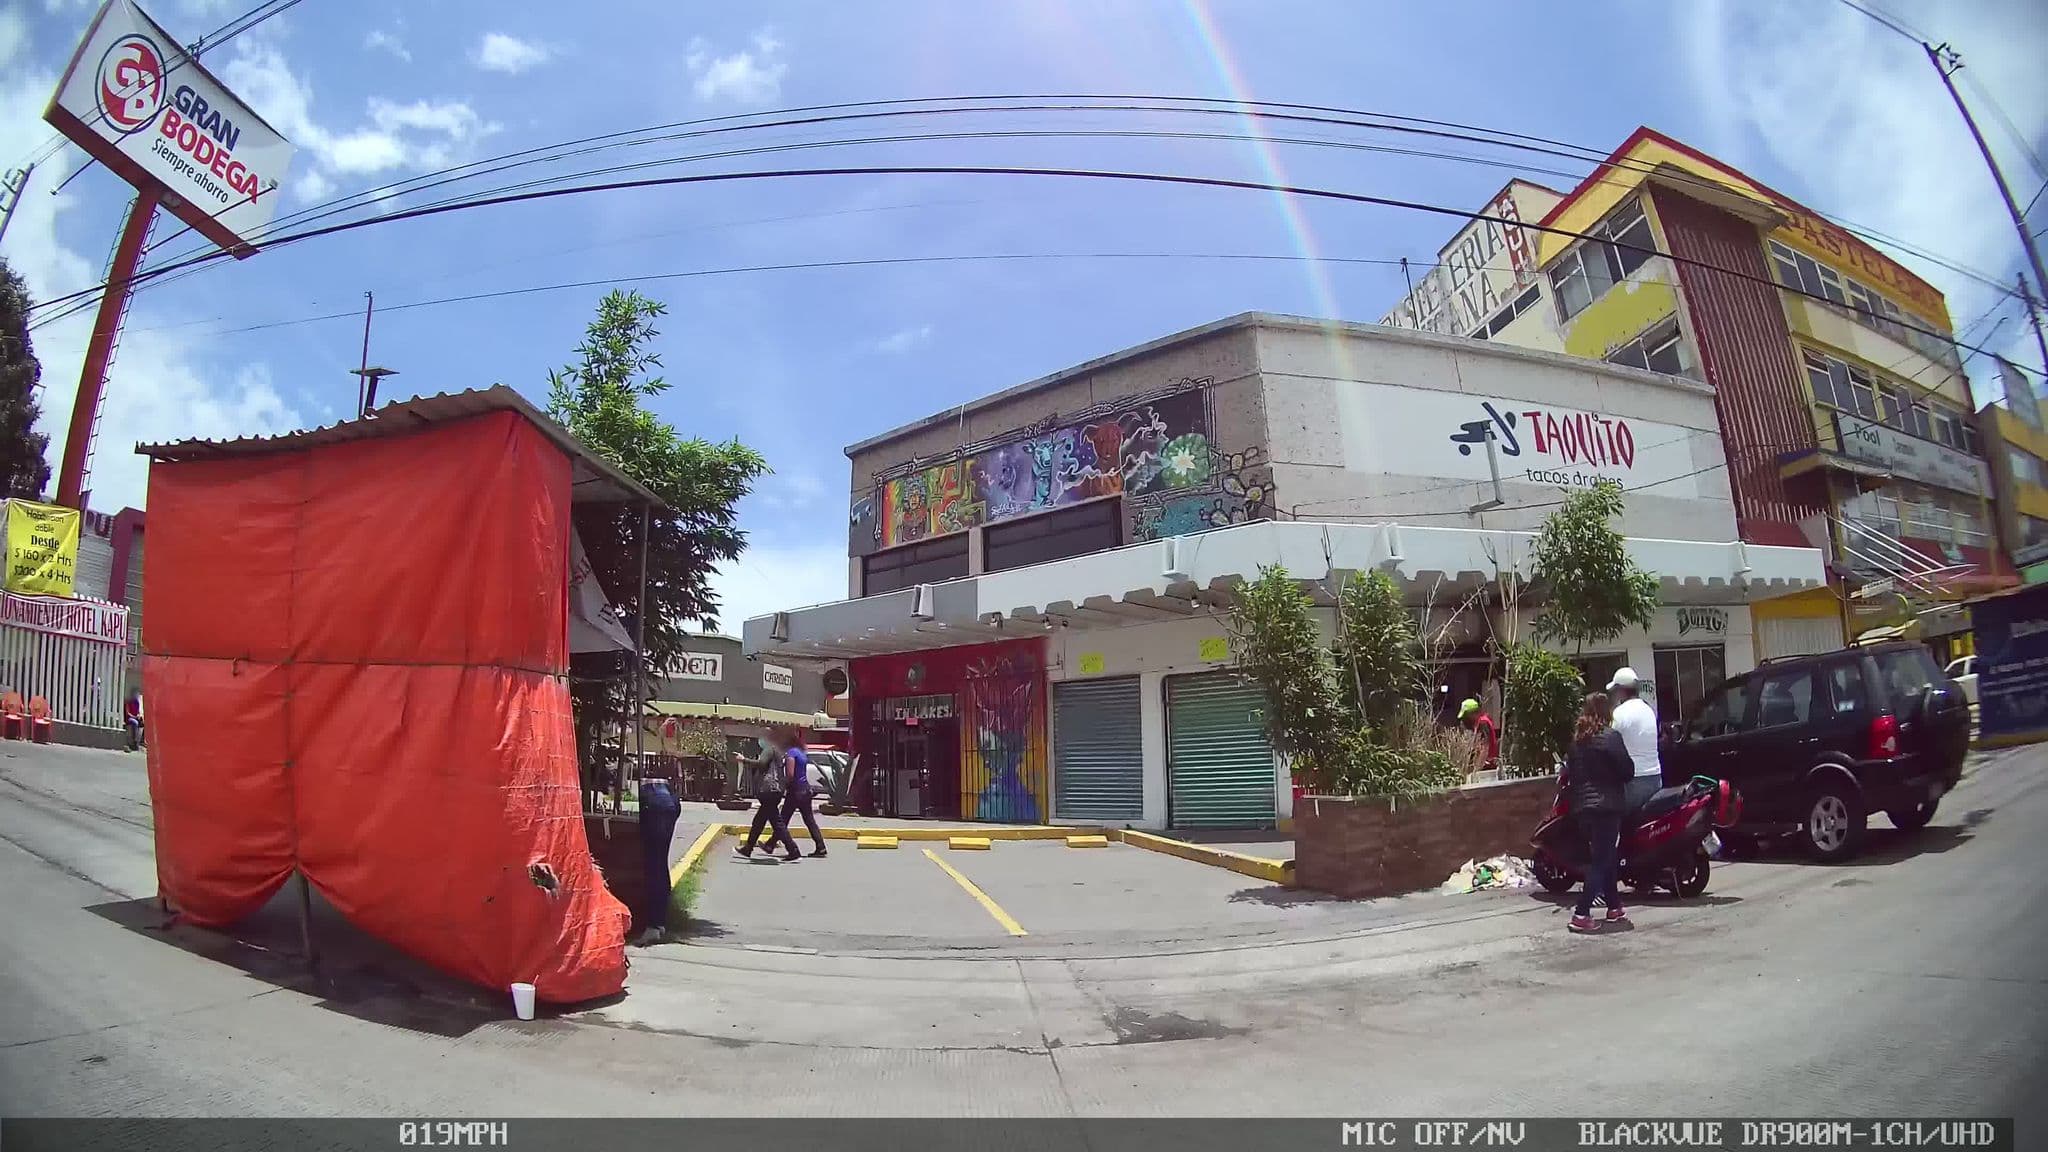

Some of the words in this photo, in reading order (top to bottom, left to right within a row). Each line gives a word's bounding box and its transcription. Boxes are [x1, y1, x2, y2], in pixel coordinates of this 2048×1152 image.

[174, 85, 240, 152] GRAN
[159, 107, 259, 205] BODEGA
[151, 138, 196, 180] Siempre
[194, 173, 229, 204] ahorro
[1853, 423, 1881, 446] Pool
[1526, 467, 1570, 485] tacos
[30, 535, 60, 549] Desde
[57, 554, 72, 567] Hrs
[56, 571, 71, 584] Hrs
[66, 606, 97, 635] HOTEL
[101, 610, 126, 640] KAPU
